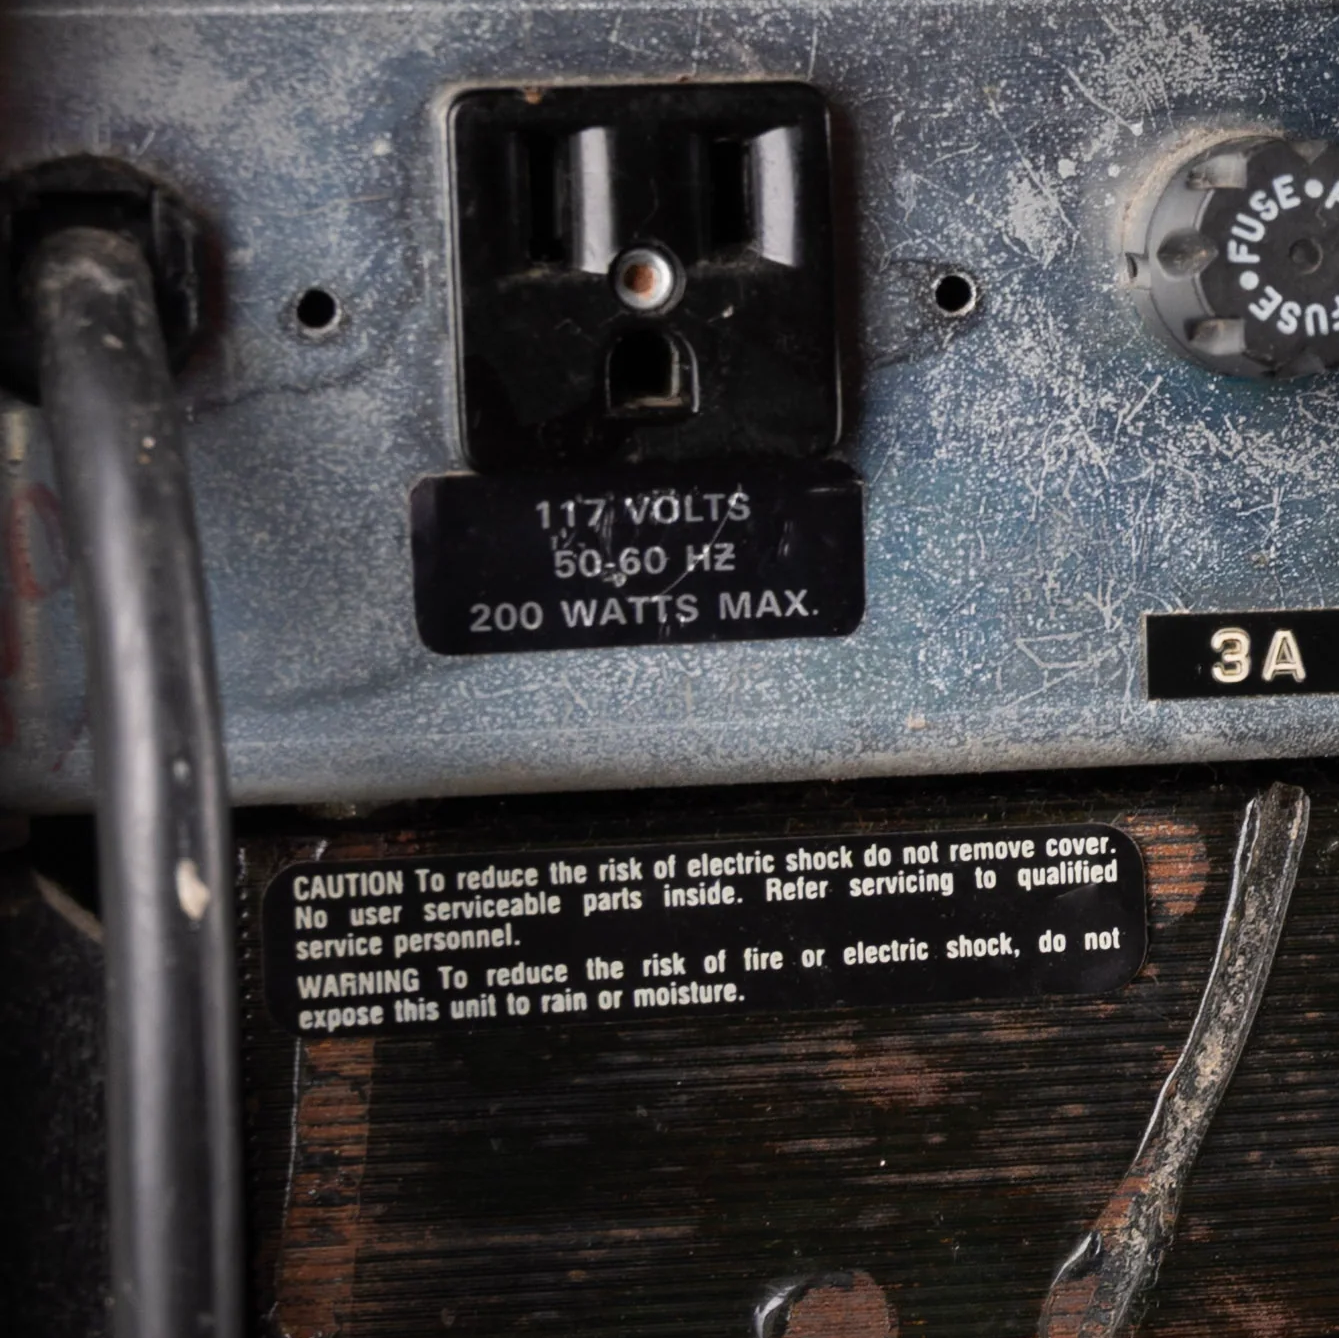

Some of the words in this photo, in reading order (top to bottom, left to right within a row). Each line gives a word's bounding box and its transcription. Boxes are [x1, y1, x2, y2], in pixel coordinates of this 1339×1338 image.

[1226, 173, 1302, 265] FUSE
[535, 499, 604, 530] 117
[623, 491, 752, 527] VOLTS
[553, 546, 668, 581] 50-60
[685, 542, 737, 574] HZ
[469, 602, 544, 634] 200
[560, 591, 700, 629] WATTS
[718, 588, 821, 621] MAX.
[1209, 626, 1308, 685] 3A
[293, 870, 403, 901] CAUTION
[415, 868, 445, 893] To
[457, 864, 539, 890] reduce
[550, 860, 587, 885] the
[599, 856, 643, 882] risk
[653, 853, 676, 878] of
[687, 850, 775, 878] electric
[785, 845, 853, 873] shock
[863, 843, 892, 867] do
[903, 840, 939, 865] not
[949, 837, 1035, 862] remove
[1045, 834, 1117, 857] cover.
[294, 906, 328, 930] No
[350, 905, 402, 928] user
[423, 891, 562, 922] serviceable
[583, 886, 643, 917] parts
[663, 878, 743, 909] inside.
[766, 876, 829, 902] Refer
[849, 870, 954, 898] servicing
[975, 866, 997, 889] to
[1017, 859, 1118, 891] qualified
[296, 932, 383, 960] service
[394, 923, 521, 958] personnel.
[297, 968, 420, 1000] WARNING
[438, 965, 468, 989] To
[486, 961, 568, 988] reduce
[586, 956, 624, 981] the
[642, 953, 686, 978] risk
[704, 949, 726, 974] of
[744, 947, 784, 972] fire
[801, 947, 825, 969] or
[843, 937, 929, 966] electric
[946, 932, 1021, 960] shock,
[1038, 929, 1067, 954] do
[1084, 926, 1121, 951] not
[299, 1004, 384, 1033] expose
[394, 997, 440, 1024] this
[450, 992, 497, 1019] unit
[506, 991, 530, 1016] to
[541, 988, 588, 1013] rain
[598, 988, 623, 1010] or
[634, 981, 746, 1008] moisture.
